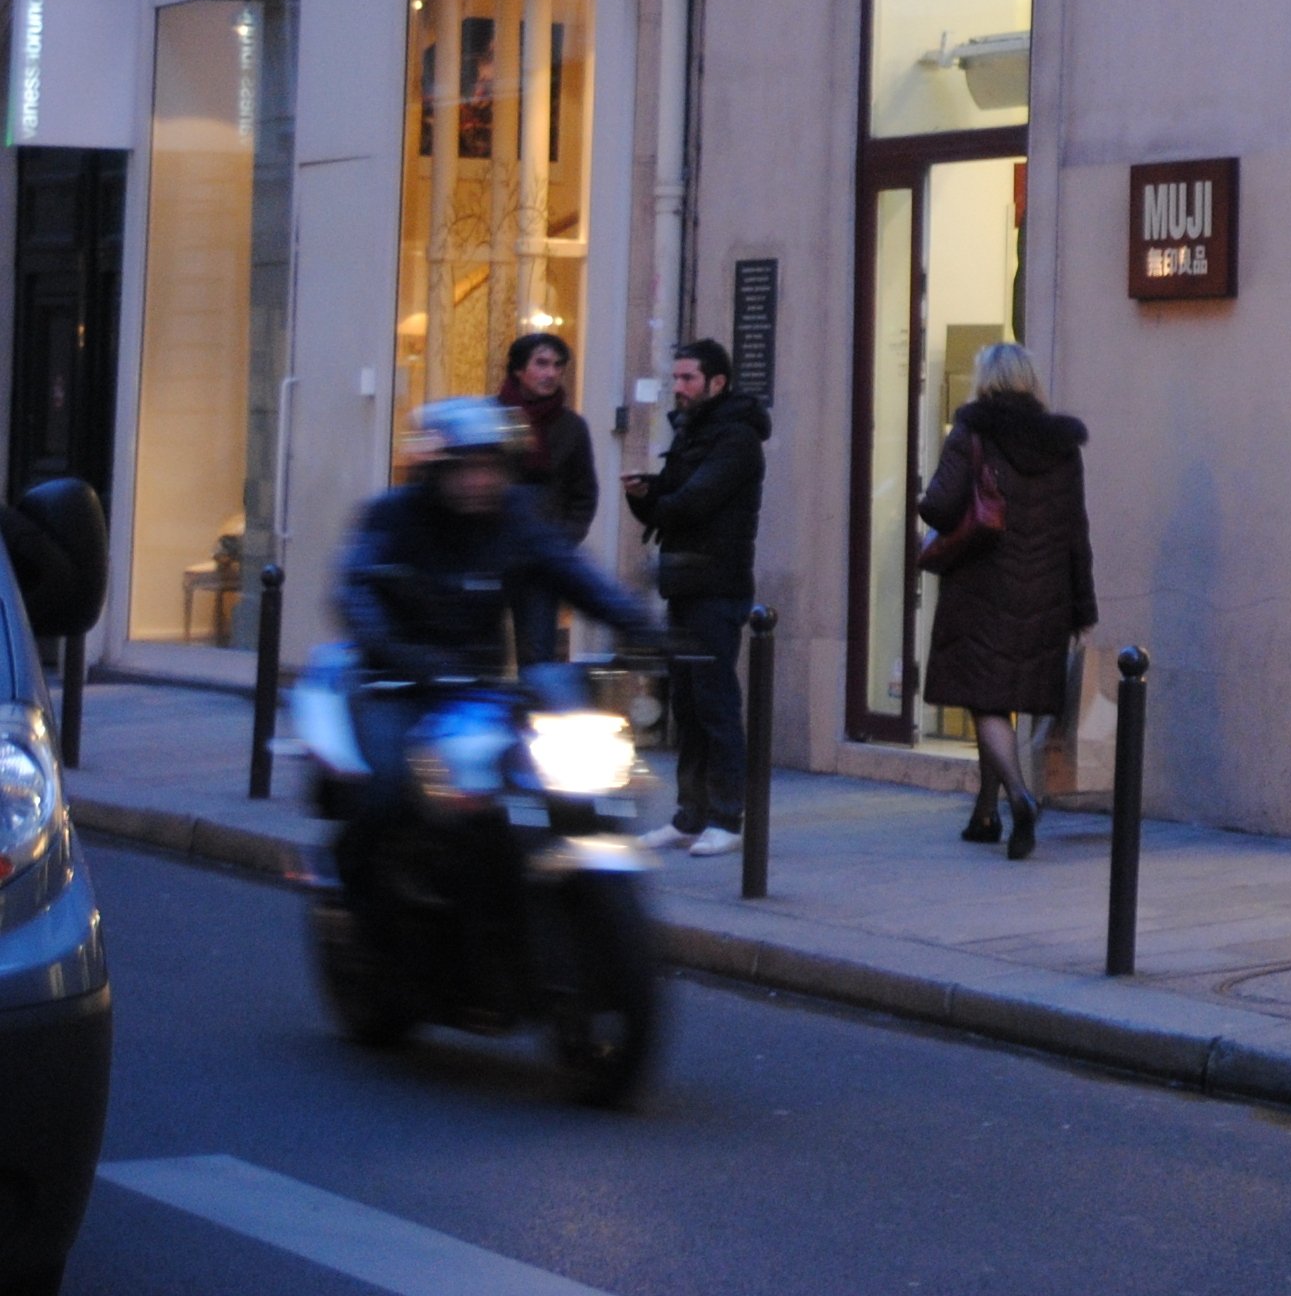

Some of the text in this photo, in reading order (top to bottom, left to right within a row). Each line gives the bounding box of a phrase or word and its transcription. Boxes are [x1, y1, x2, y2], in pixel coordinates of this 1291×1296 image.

[1144, 181, 1212, 240] MUJI
[1147, 245, 1208, 277] 無印良品
